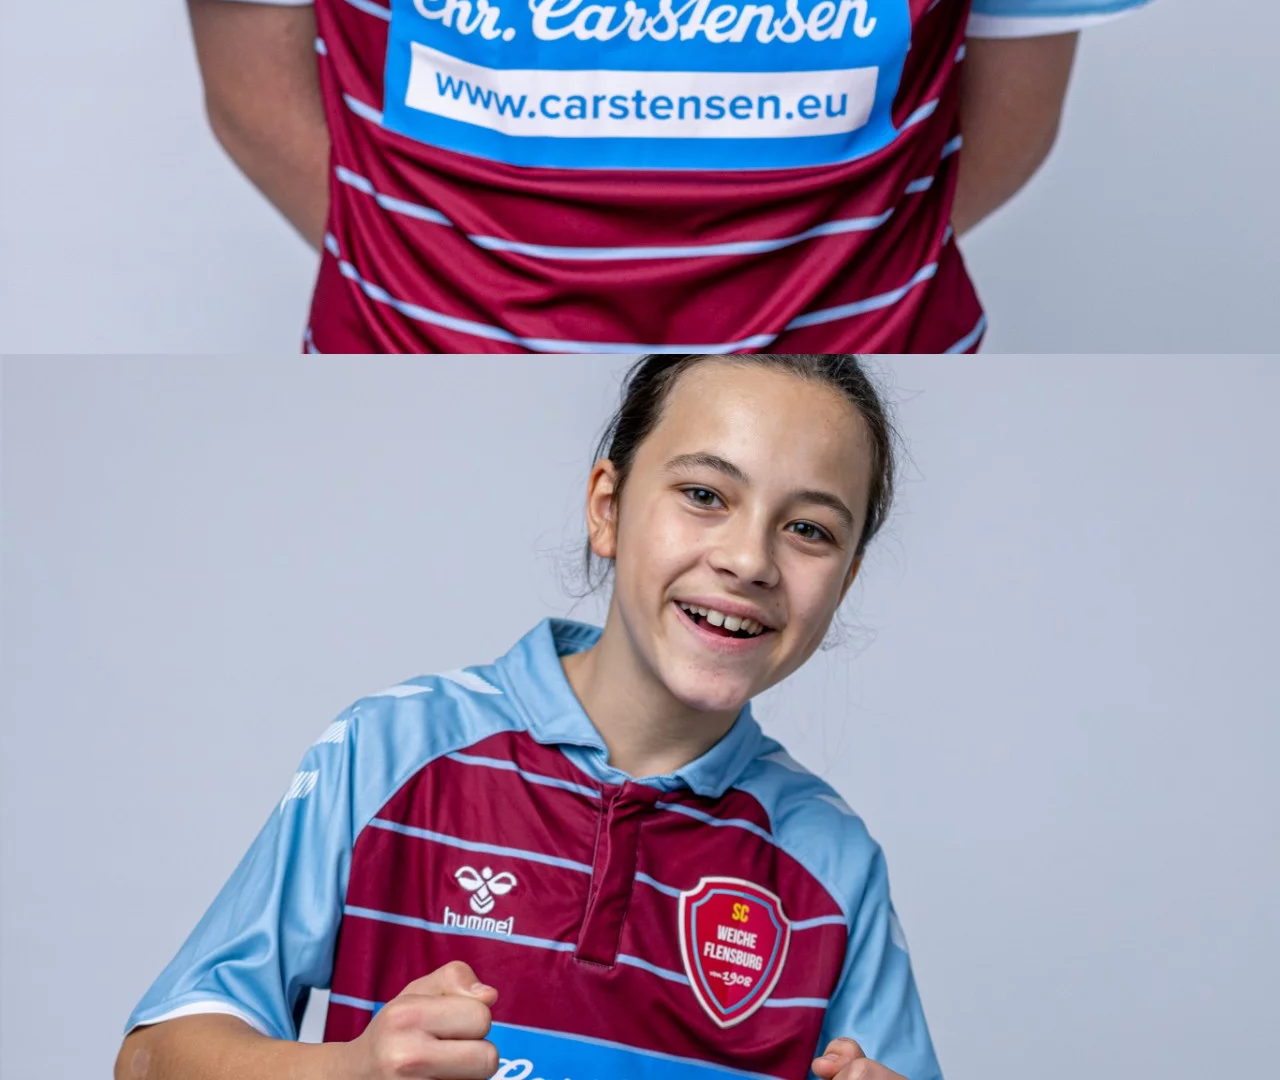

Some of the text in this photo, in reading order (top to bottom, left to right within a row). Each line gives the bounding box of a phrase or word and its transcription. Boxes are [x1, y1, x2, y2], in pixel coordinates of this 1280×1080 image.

[435, 70, 848, 120] www.carstensen.eu
[444, 906, 515, 936] hummel
[731, 902, 750, 923] SC
[717, 924, 758, 950] WEICHE
[703, 941, 763, 971] FLENSBURG
